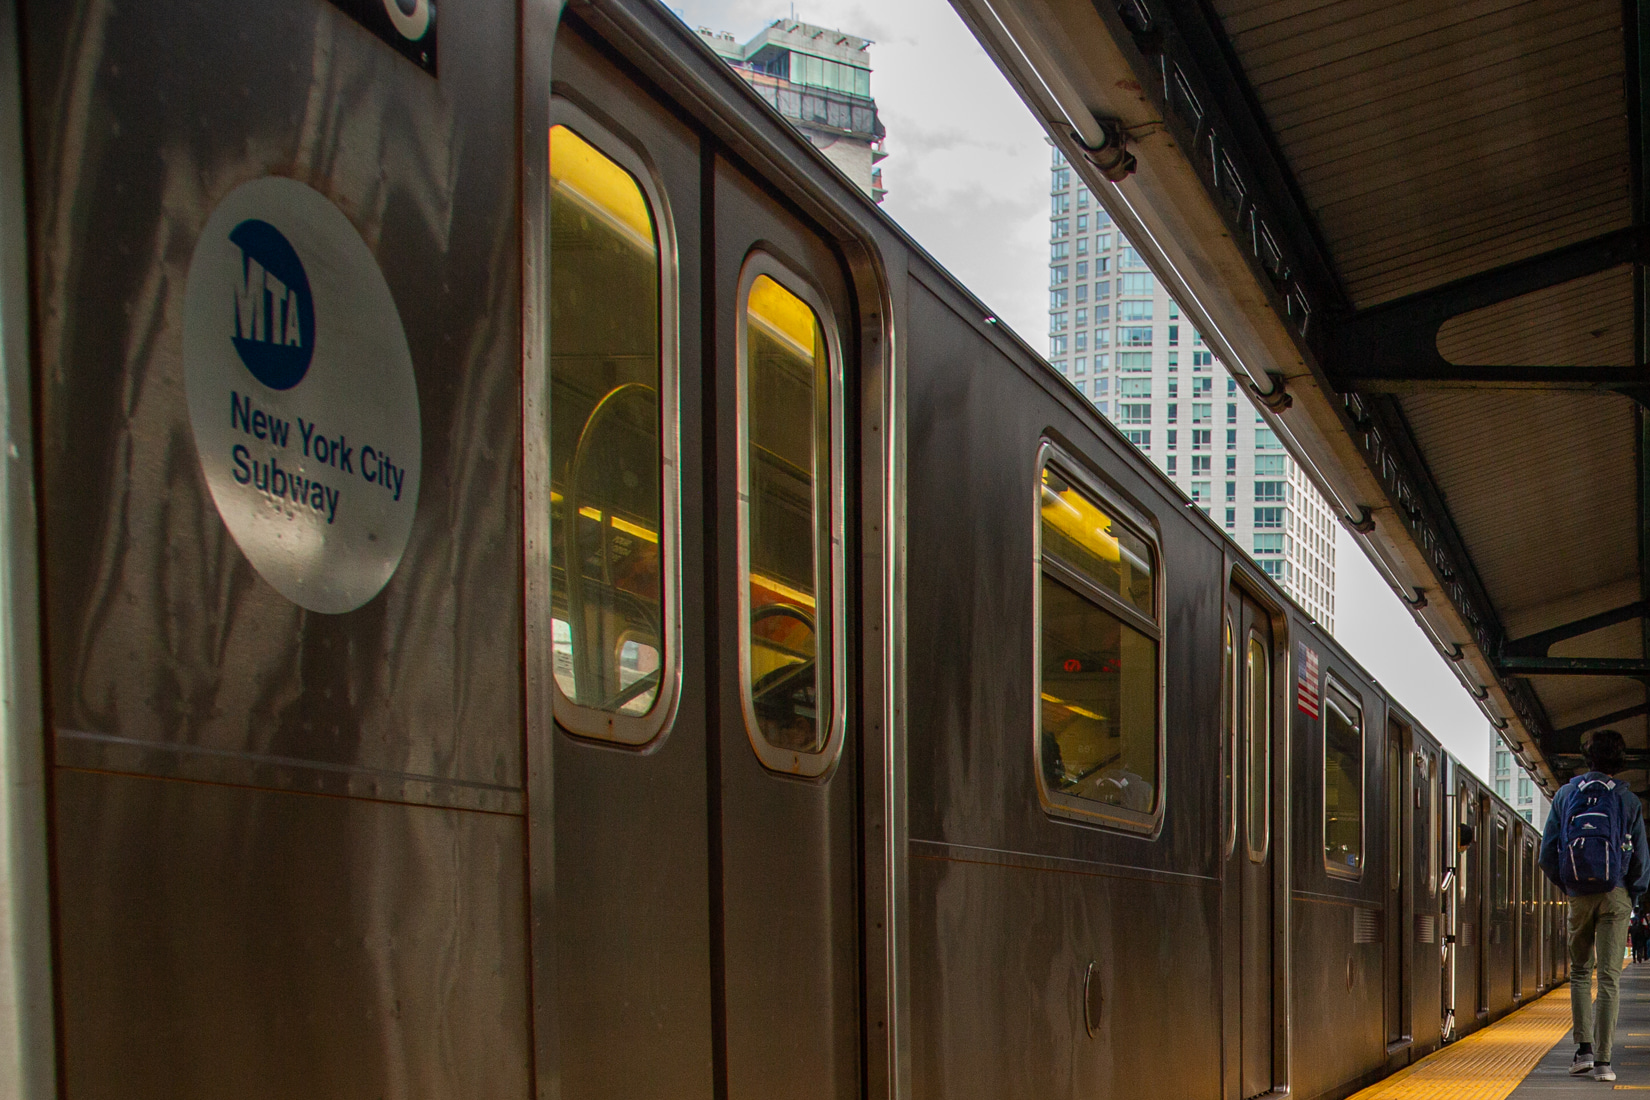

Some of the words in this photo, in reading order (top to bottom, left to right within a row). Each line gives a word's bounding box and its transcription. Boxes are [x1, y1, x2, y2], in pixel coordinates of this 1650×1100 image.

[231, 250, 302, 349] MTA
[230, 391, 289, 445] New
[298, 417, 354, 474] York
[361, 444, 406, 502] City
[232, 444, 340, 524] Subway
